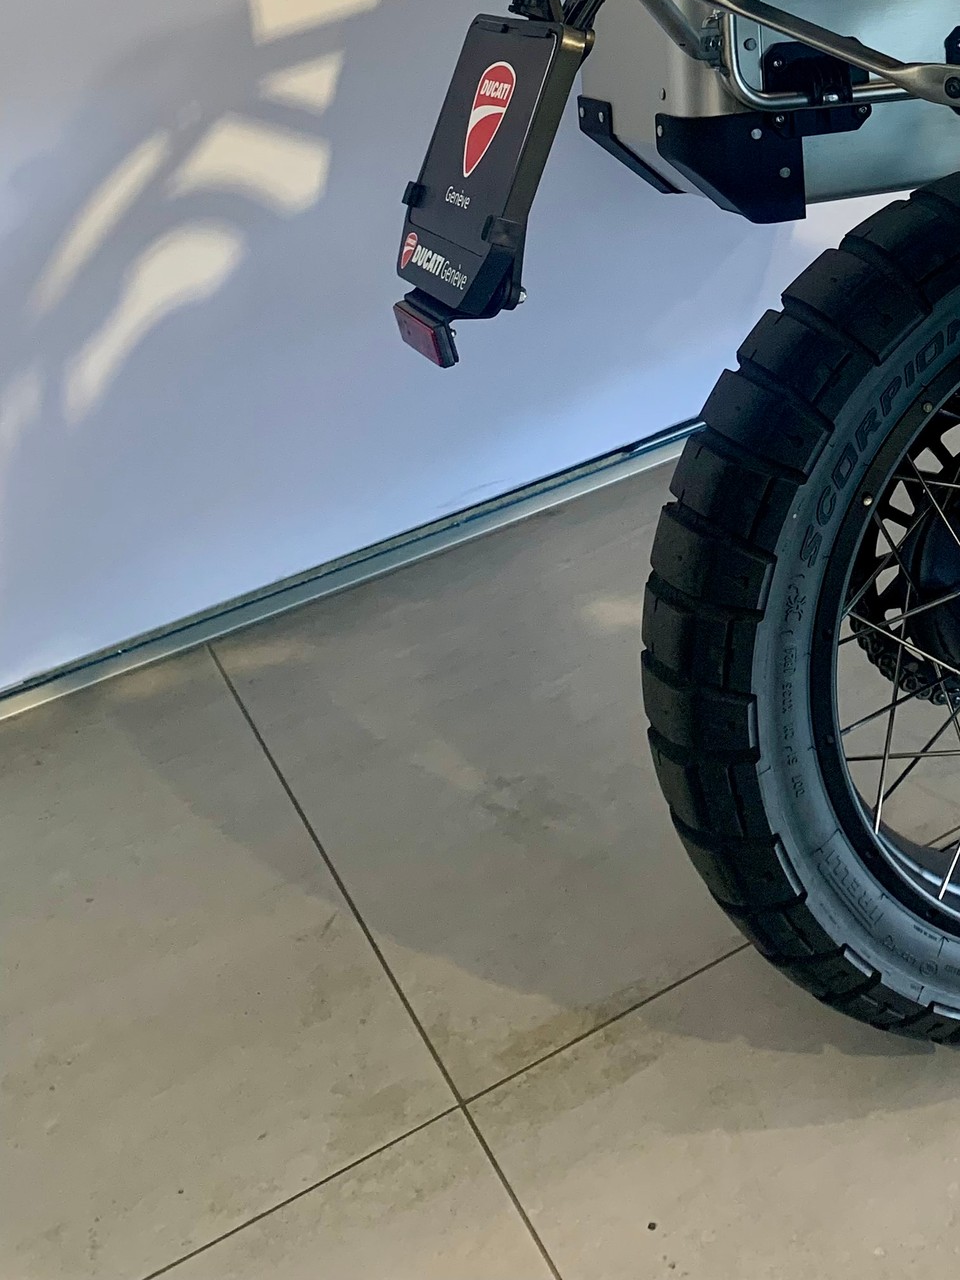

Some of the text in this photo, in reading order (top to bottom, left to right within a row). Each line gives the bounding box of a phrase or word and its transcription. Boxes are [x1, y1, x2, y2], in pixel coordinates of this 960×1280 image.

[480, 79, 512, 100] DUCATI
[445, 185, 471, 210] Genève
[411, 244, 468, 291] DUCATI Genève
